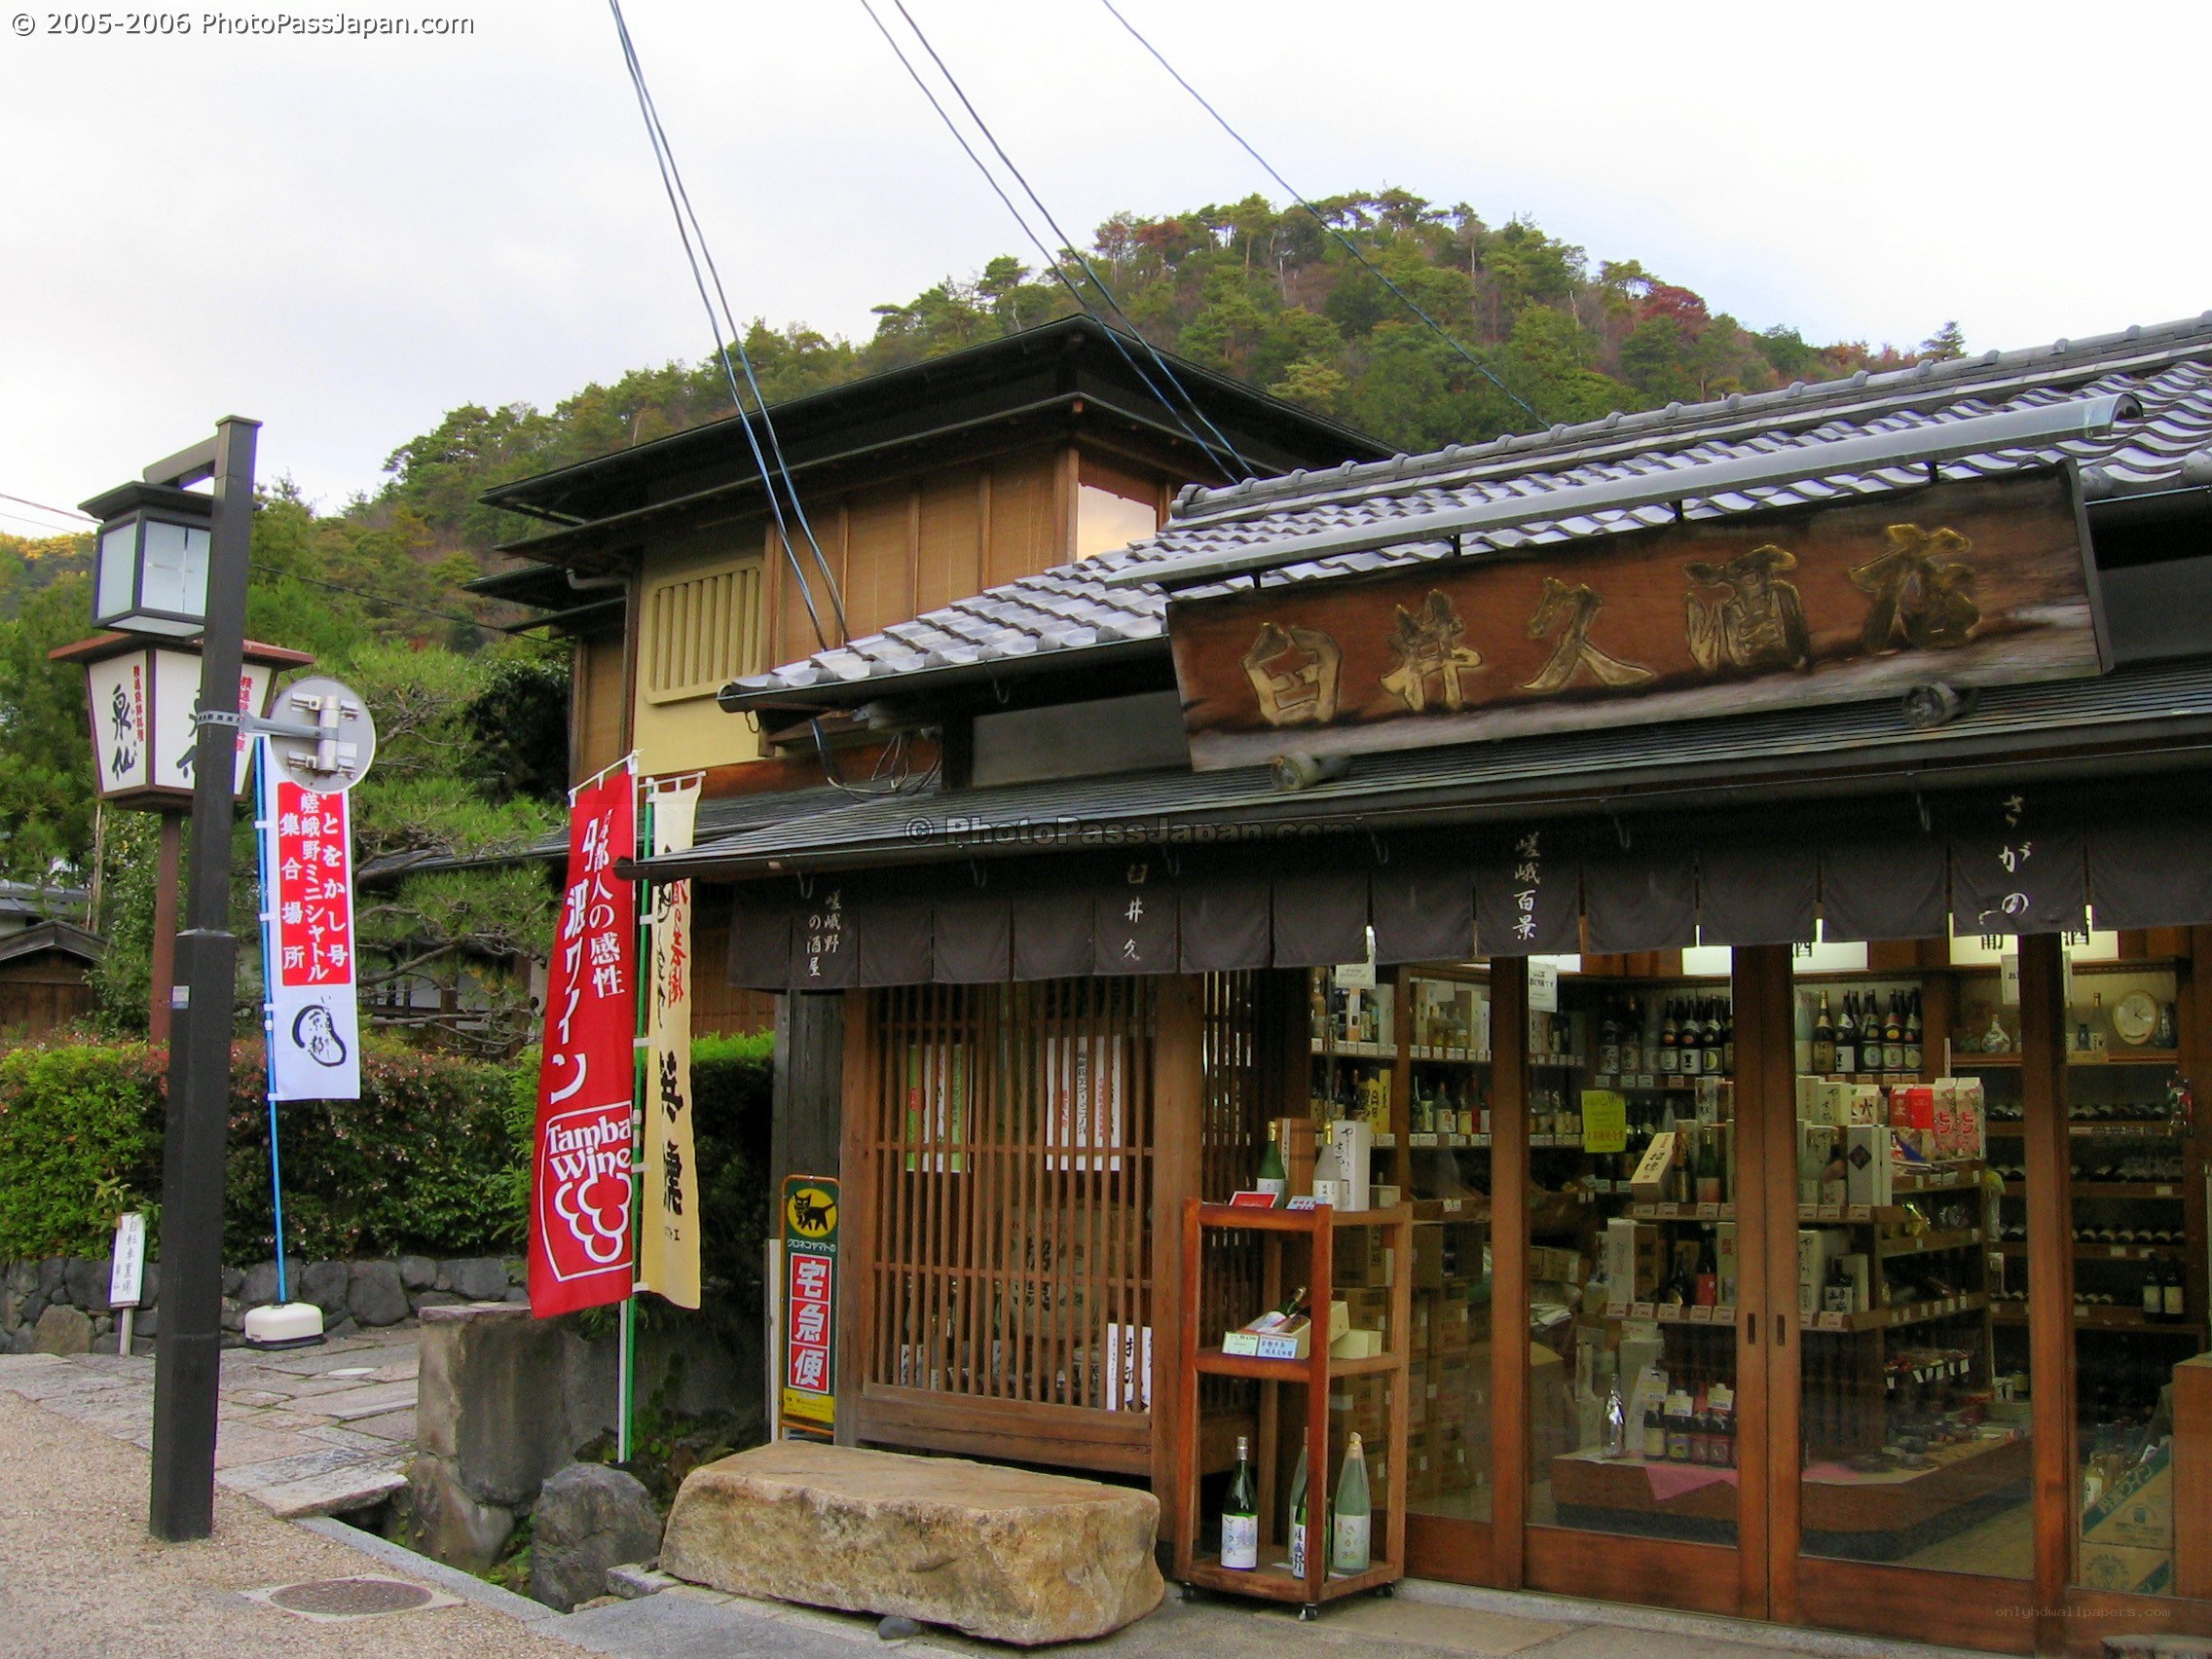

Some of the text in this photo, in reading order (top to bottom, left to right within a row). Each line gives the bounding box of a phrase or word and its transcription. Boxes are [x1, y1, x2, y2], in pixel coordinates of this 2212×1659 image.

[278, 813, 304, 971] 集合場所
[320, 791, 349, 968] とをかし号
[1512, 831, 1541, 940] 嵯峨百景
[547, 1116, 632, 1155] Tamba
[550, 1145, 632, 1182] Wine
[794, 1259, 828, 1388] 宅急便
